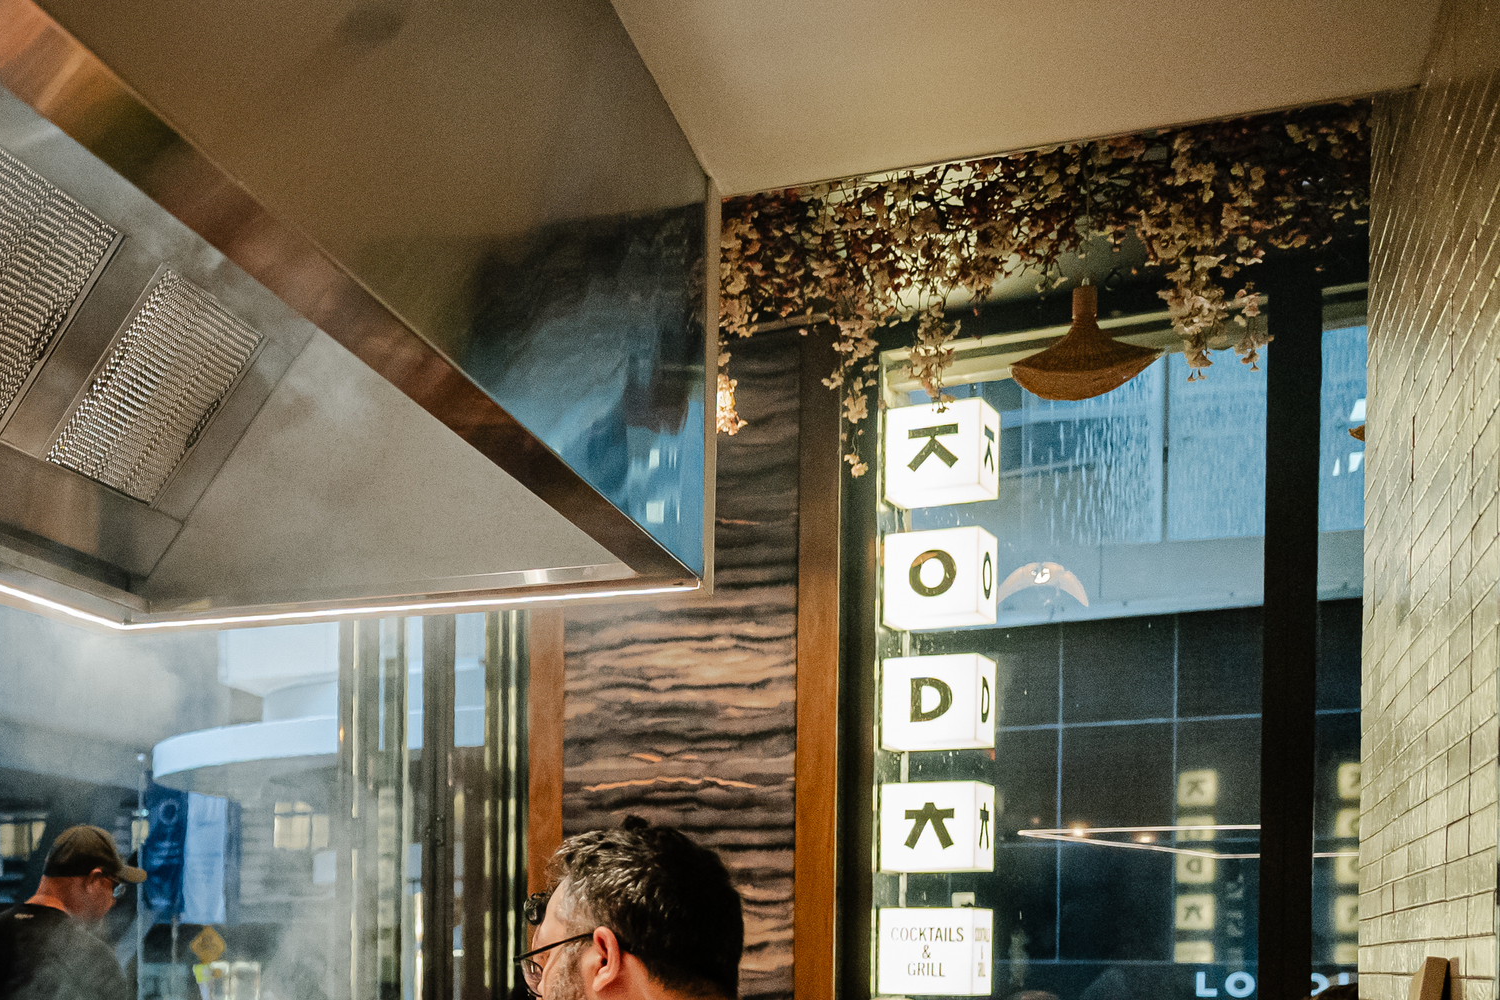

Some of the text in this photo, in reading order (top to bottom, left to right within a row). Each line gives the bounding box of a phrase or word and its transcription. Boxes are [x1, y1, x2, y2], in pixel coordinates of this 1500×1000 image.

[890, 926, 964, 943] COCKTAILS
[921, 944, 932, 960] &
[907, 961, 946, 978] GRILL
